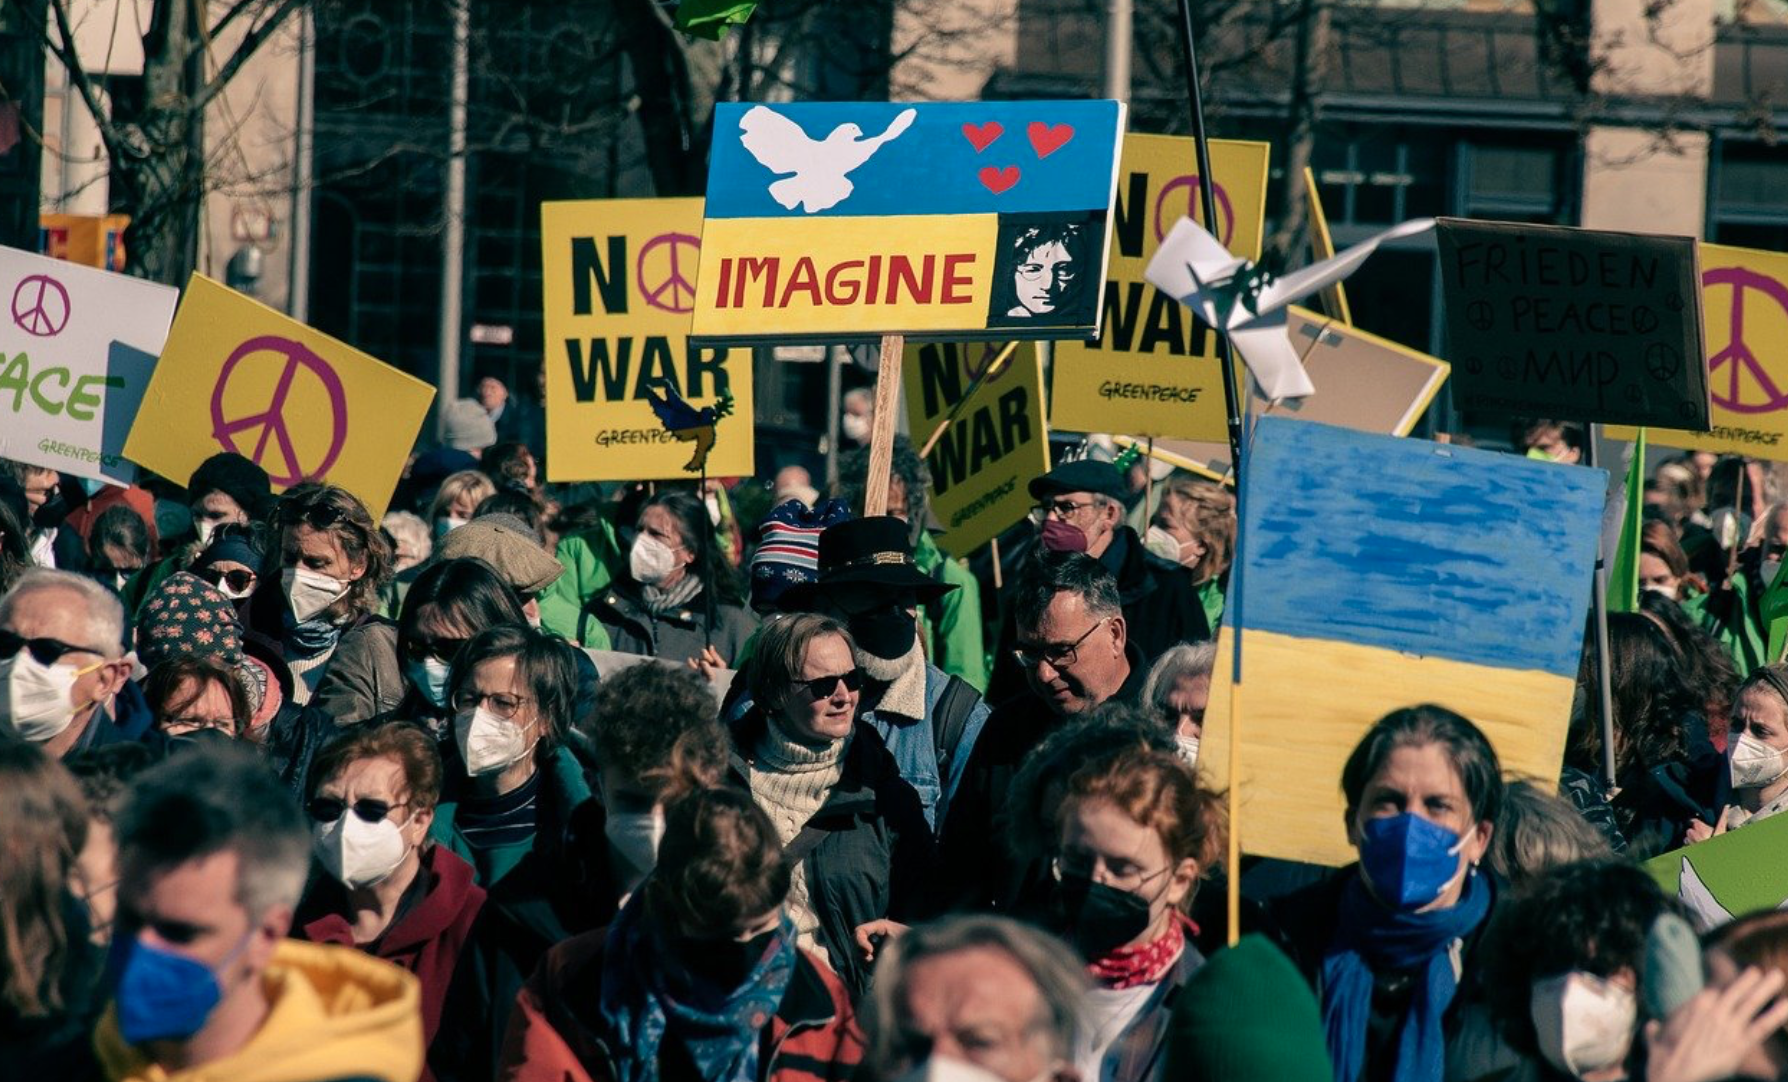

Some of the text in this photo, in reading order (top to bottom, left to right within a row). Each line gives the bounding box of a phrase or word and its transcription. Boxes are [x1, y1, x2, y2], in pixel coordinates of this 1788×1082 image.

[715, 253, 976, 308] IMAGINE
[1511, 296, 1628, 335] PEACE
[0, 352, 125, 421] ACE
[564, 335, 731, 403] WAR
[1100, 381, 1202, 403] GREENPEACE
[38, 438, 122, 468] GREENPEACE
[922, 386, 1031, 497] WAR
